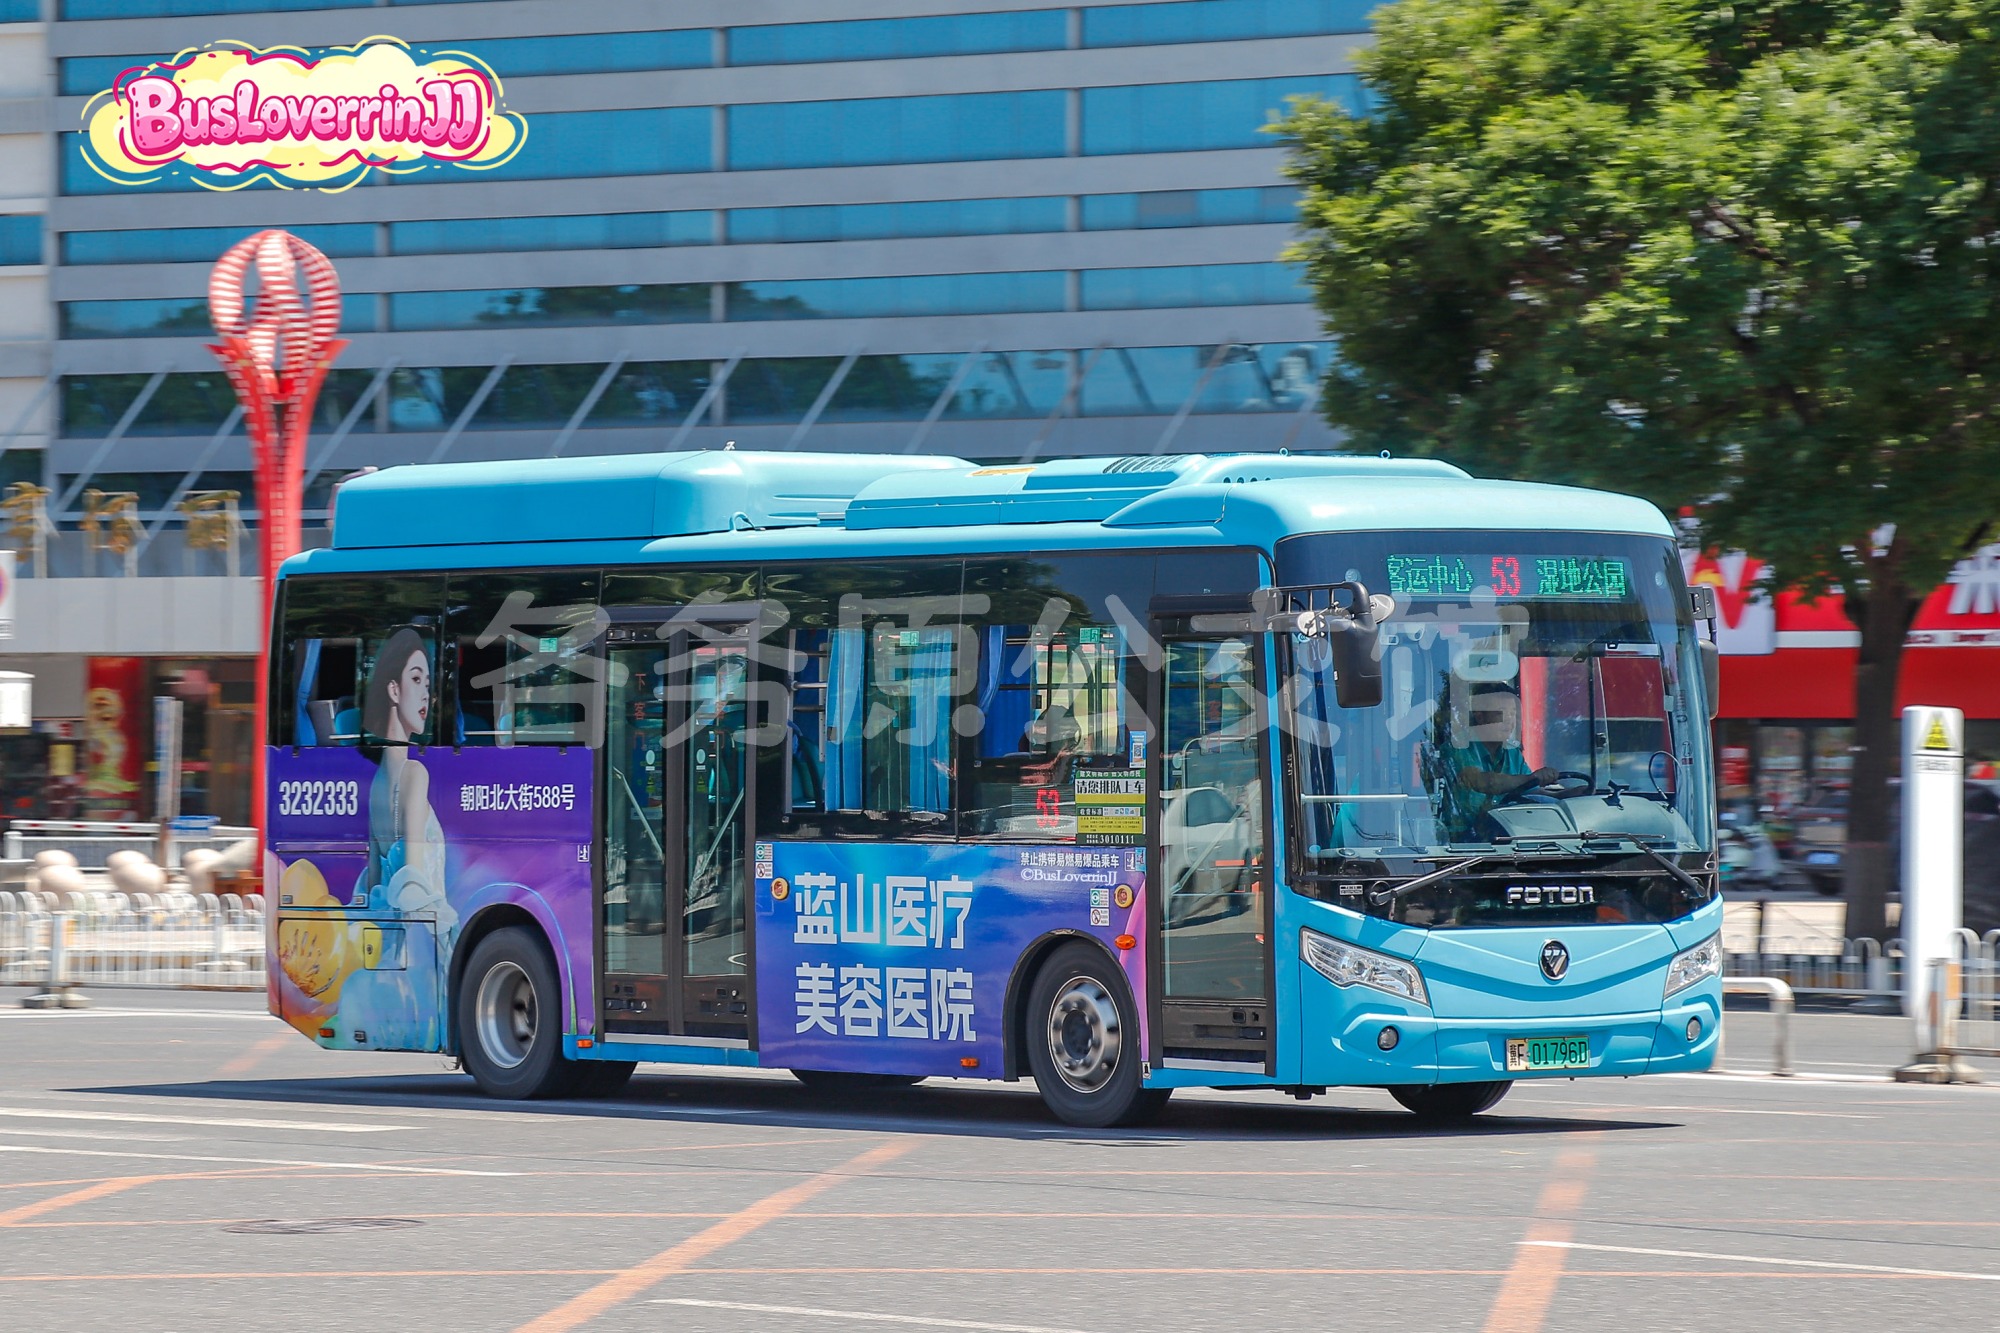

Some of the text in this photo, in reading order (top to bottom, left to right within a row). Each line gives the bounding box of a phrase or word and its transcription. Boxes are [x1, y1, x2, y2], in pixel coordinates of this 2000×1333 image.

[1387, 554, 1627, 597] 客运中心 53 湿地公园
[278, 781, 359, 816] 3232333
[460, 783, 576, 811] 朝阳北大街588号
[1077, 780, 1145, 794] 请您排队上车
[1036, 788, 1060, 828] 53
[1099, 834, 1135, 844] 3010111
[1020, 852, 1120, 869] 禁止携带易燃易爆品乘车
[793, 872, 974, 949] 蓝山医疗
[1507, 886, 1596, 904] FOTON
[794, 962, 977, 1042] 美容医院
